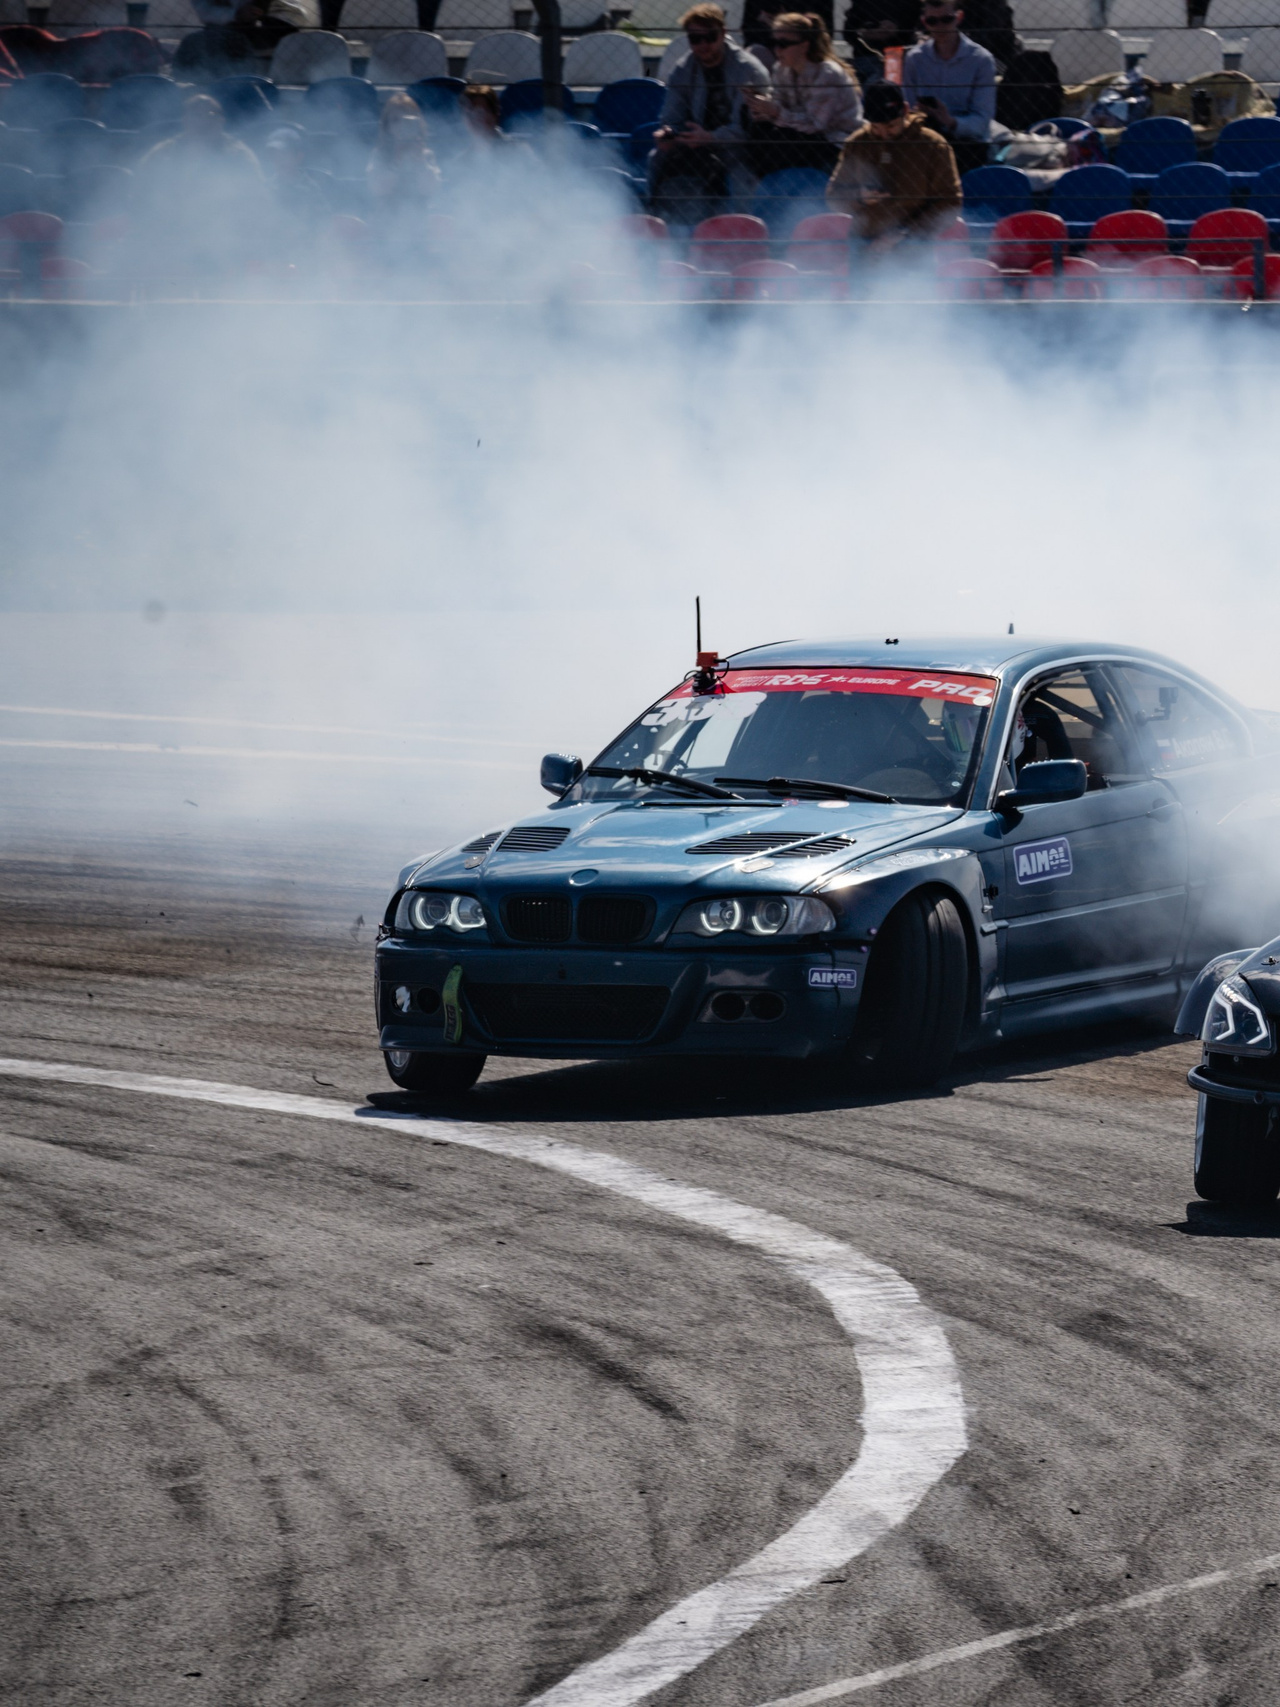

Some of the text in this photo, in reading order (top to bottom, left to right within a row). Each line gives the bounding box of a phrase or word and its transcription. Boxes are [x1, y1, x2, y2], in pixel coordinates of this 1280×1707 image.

[764, 674, 993, 698] RDS EUROPE PRO
[1018, 846, 1070, 877] AIMOL
[810, 972, 854, 985] AIMOL
